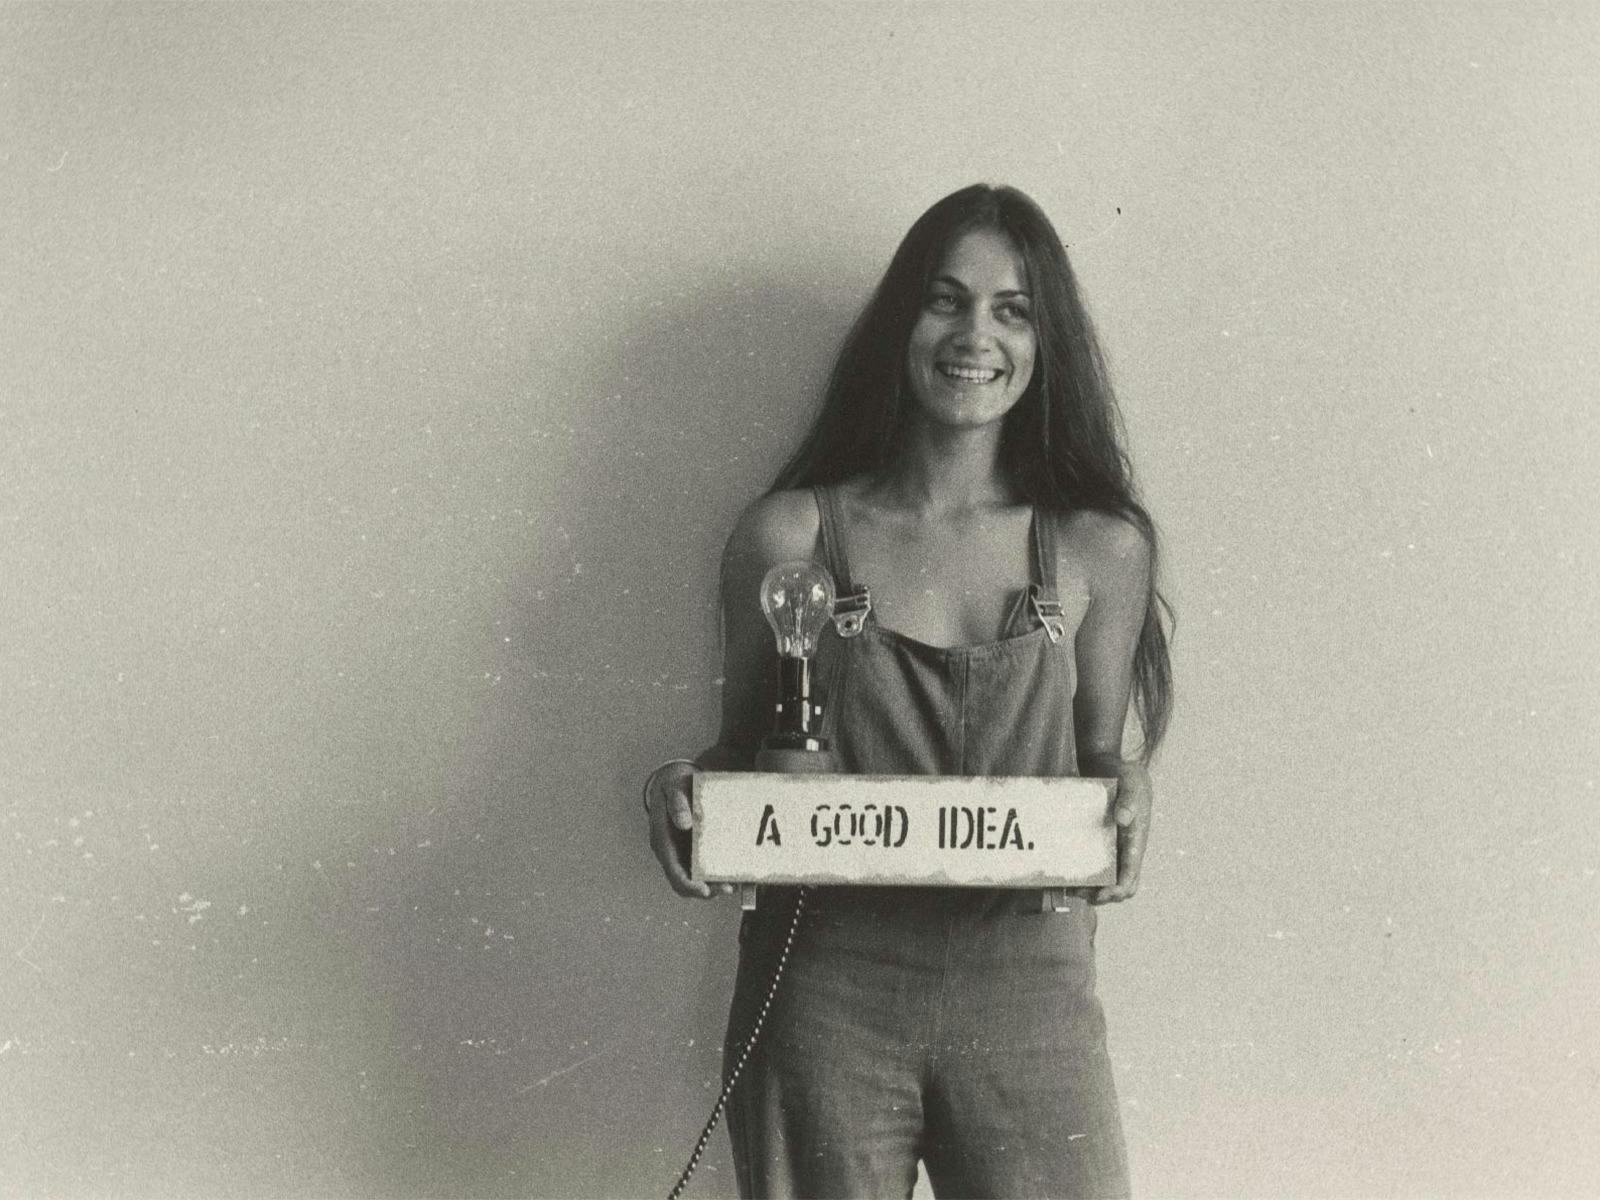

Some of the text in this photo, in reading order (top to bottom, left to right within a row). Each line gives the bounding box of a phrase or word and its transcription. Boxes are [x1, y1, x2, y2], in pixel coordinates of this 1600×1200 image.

[755, 803, 1035, 850] A GOOD IDEA.
